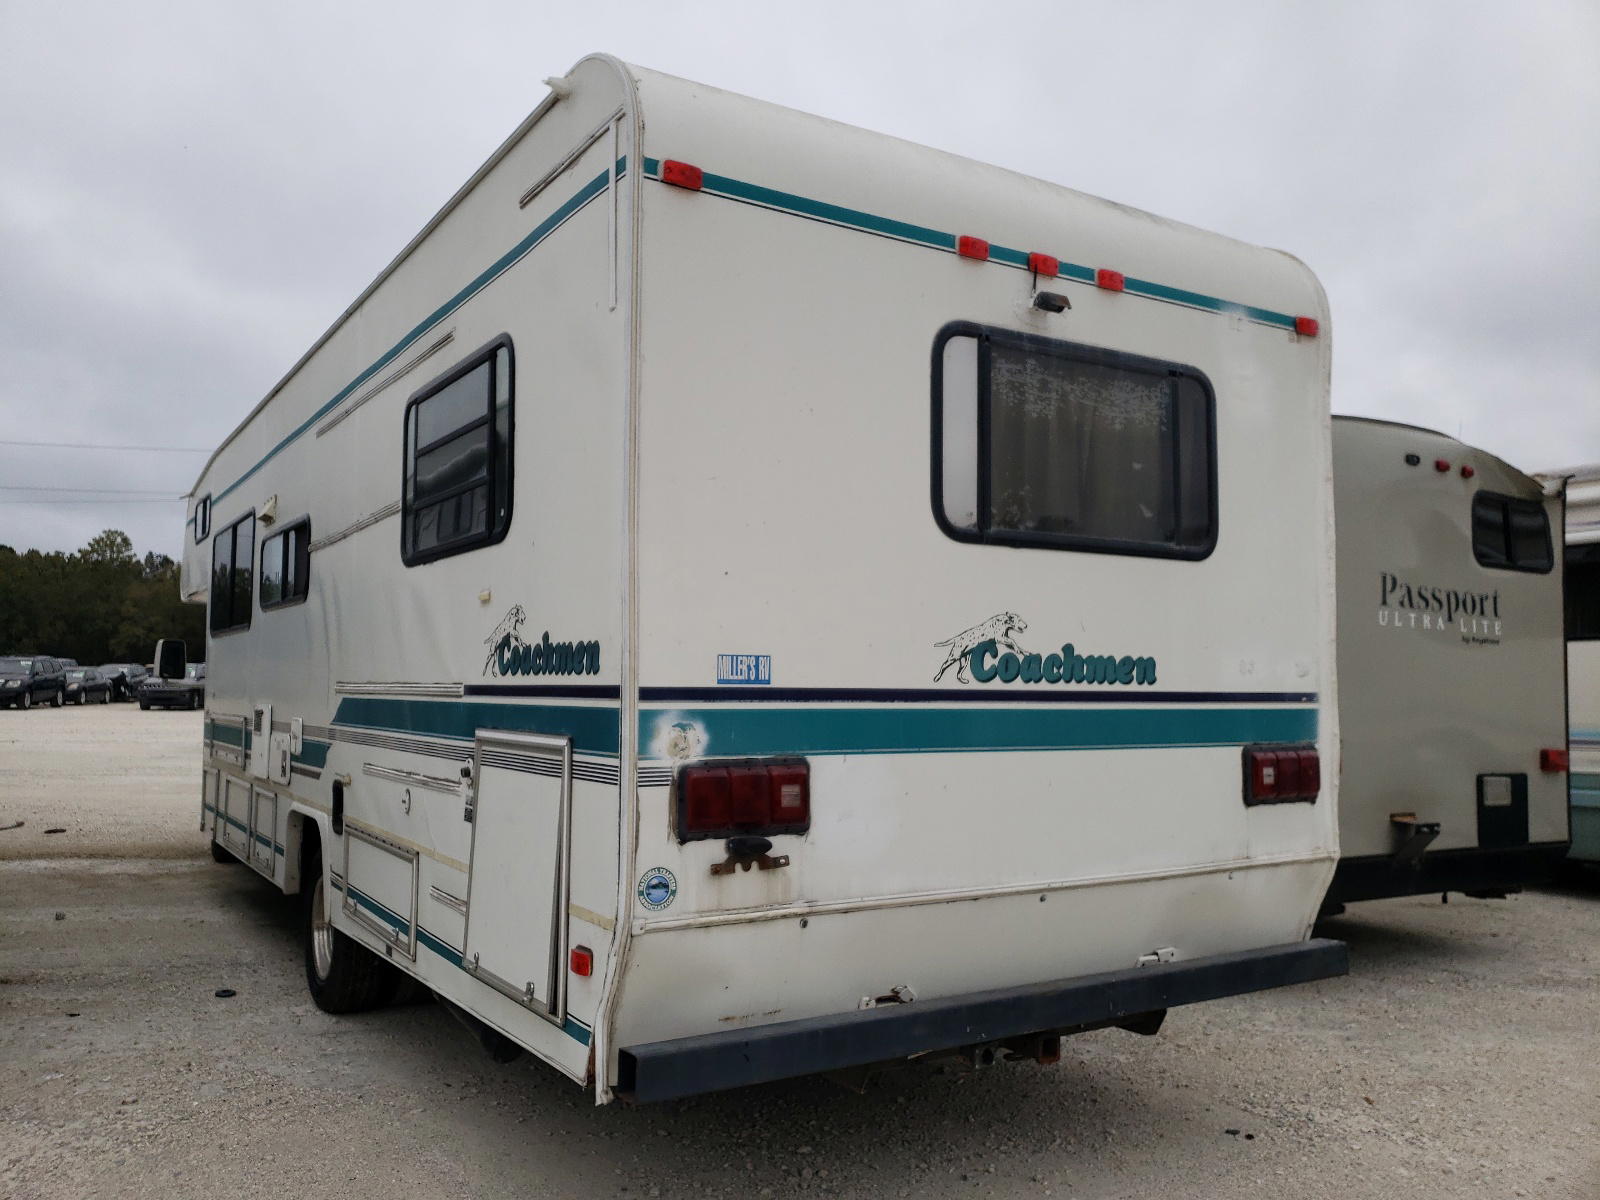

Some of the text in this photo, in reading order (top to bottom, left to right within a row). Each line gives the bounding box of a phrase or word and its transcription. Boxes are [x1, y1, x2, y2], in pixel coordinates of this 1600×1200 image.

[1380, 572, 1500, 622] Passport
[1379, 610, 1502, 636] ULTRA LITE
[497, 630, 600, 676] Coachmen
[969, 638, 1157, 685] Coachmen
